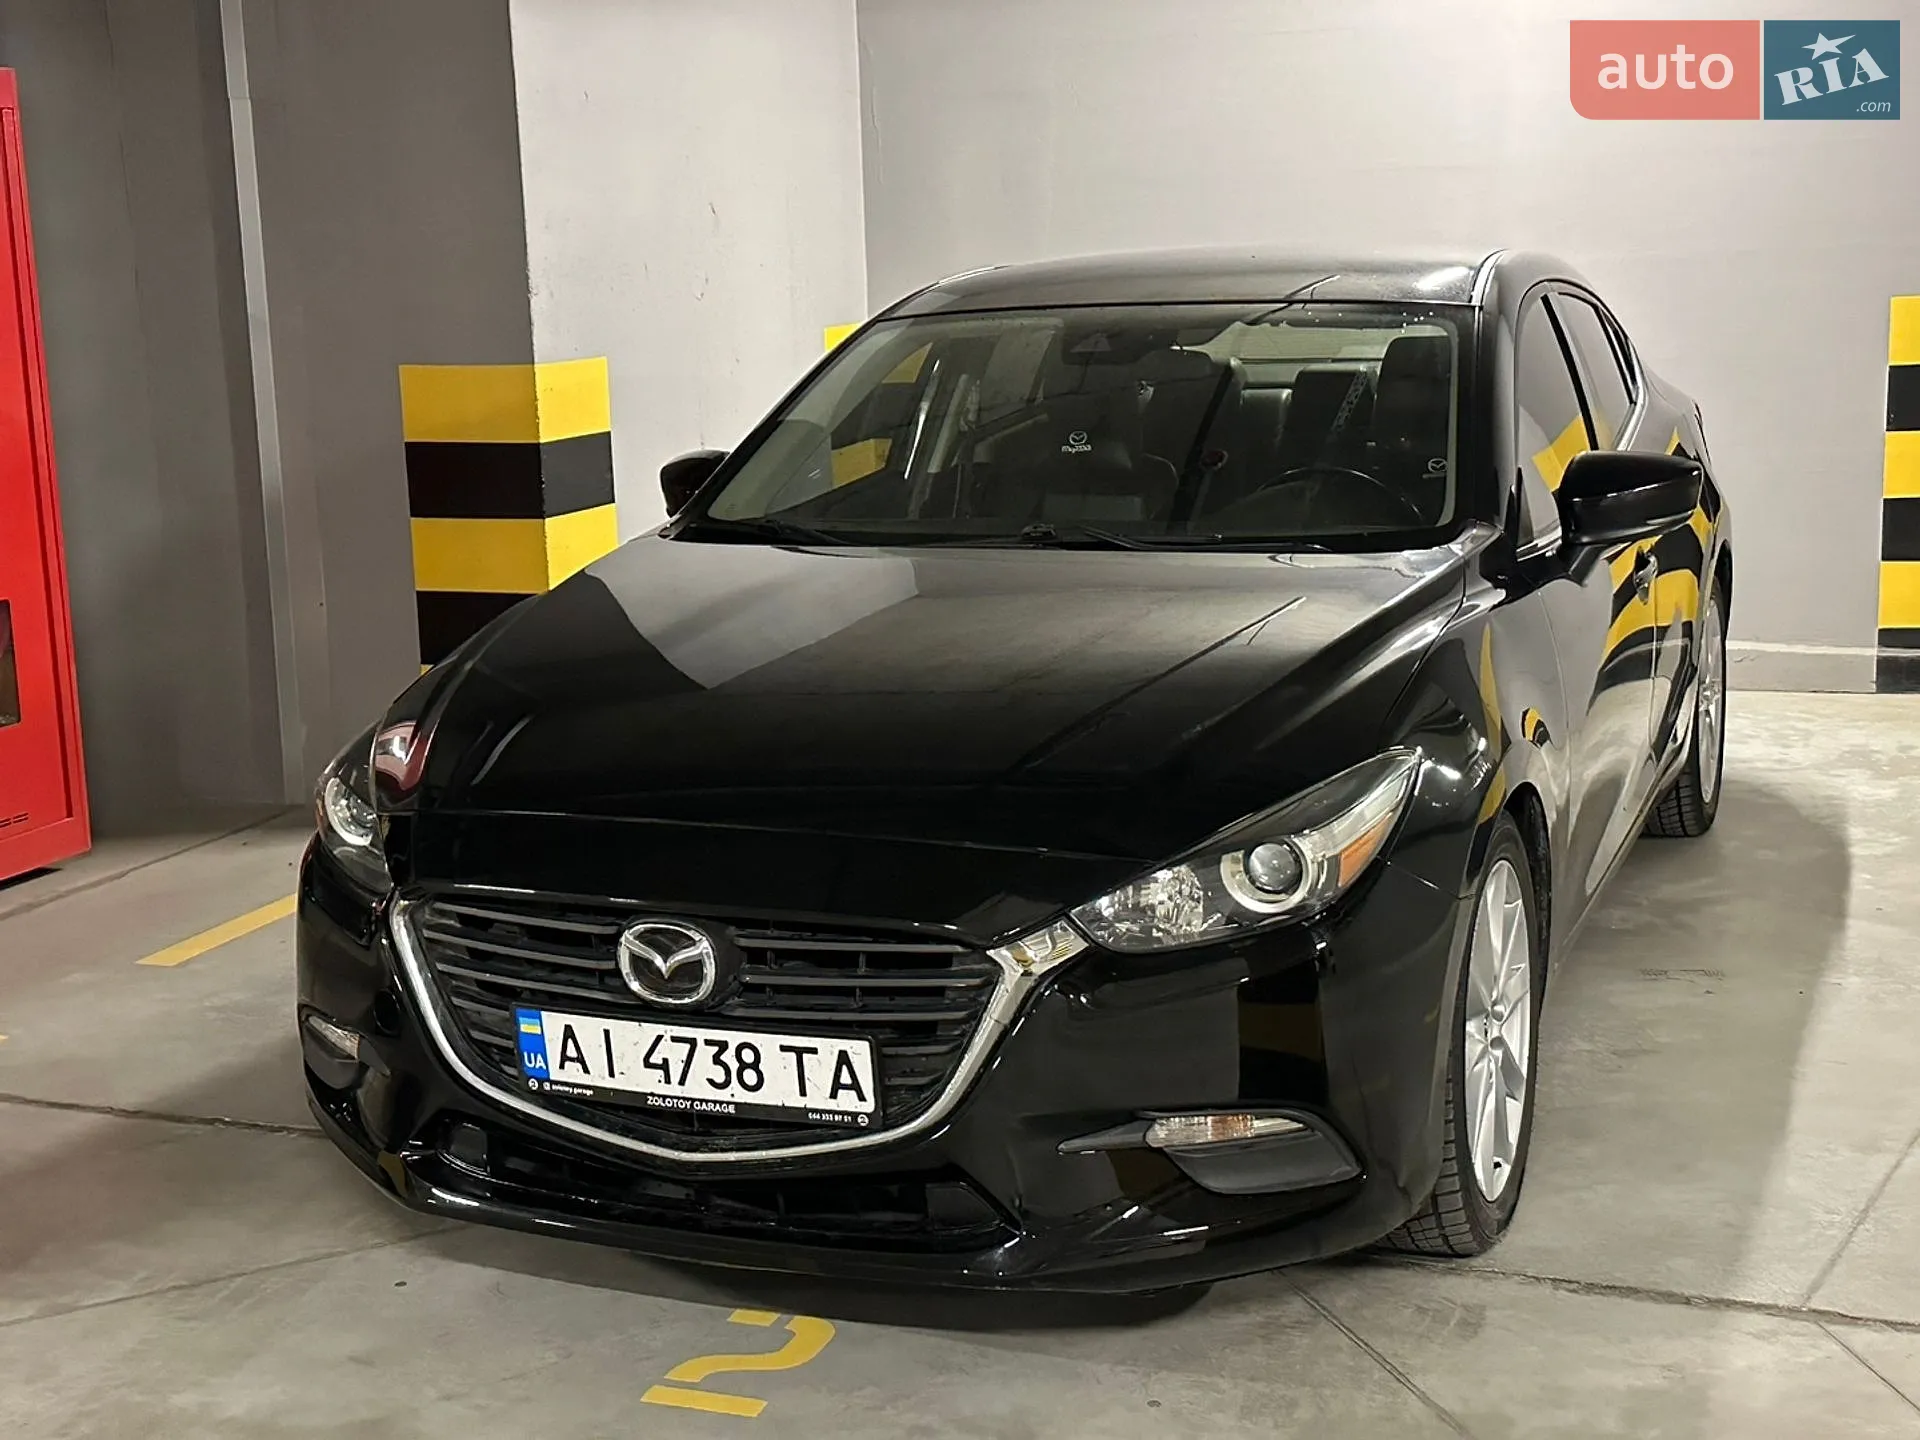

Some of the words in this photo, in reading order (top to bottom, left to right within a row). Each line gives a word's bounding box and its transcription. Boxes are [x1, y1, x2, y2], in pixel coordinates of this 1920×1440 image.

[523, 1051, 547, 1070] UA
[558, 1023, 616, 1079] AI
[642, 1034, 765, 1092] 4738
[778, 1044, 868, 1102] TA
[646, 1095, 692, 1110] ZOLOTOY
[693, 1101, 736, 1114] GARAGE
[640, 1308, 836, 1418] 2
